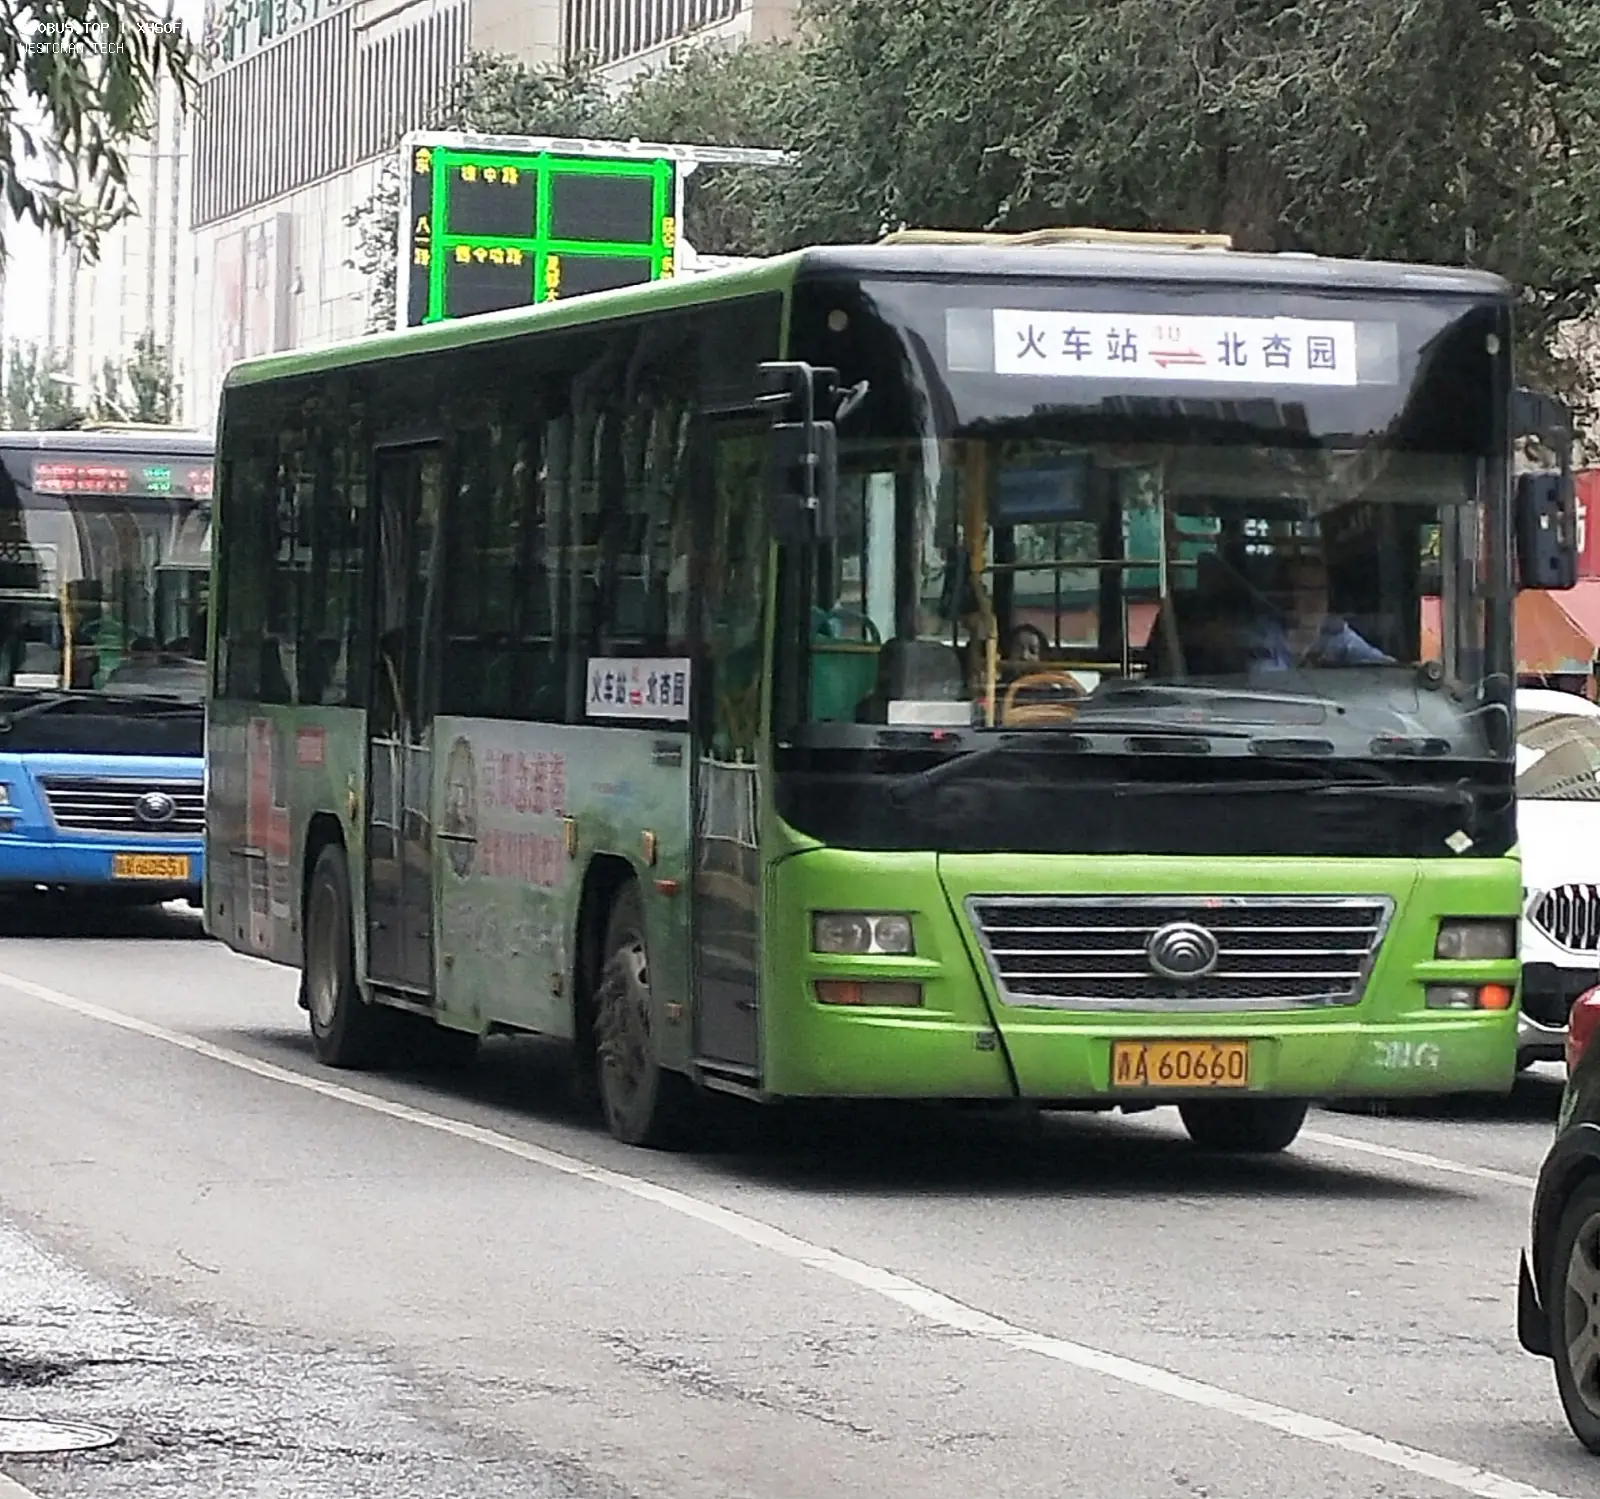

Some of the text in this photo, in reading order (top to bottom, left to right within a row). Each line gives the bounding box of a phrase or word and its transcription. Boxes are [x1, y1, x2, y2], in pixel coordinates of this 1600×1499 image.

[1016, 323, 1137, 364] 火车站
[1217, 331, 1337, 370] 北杏园
